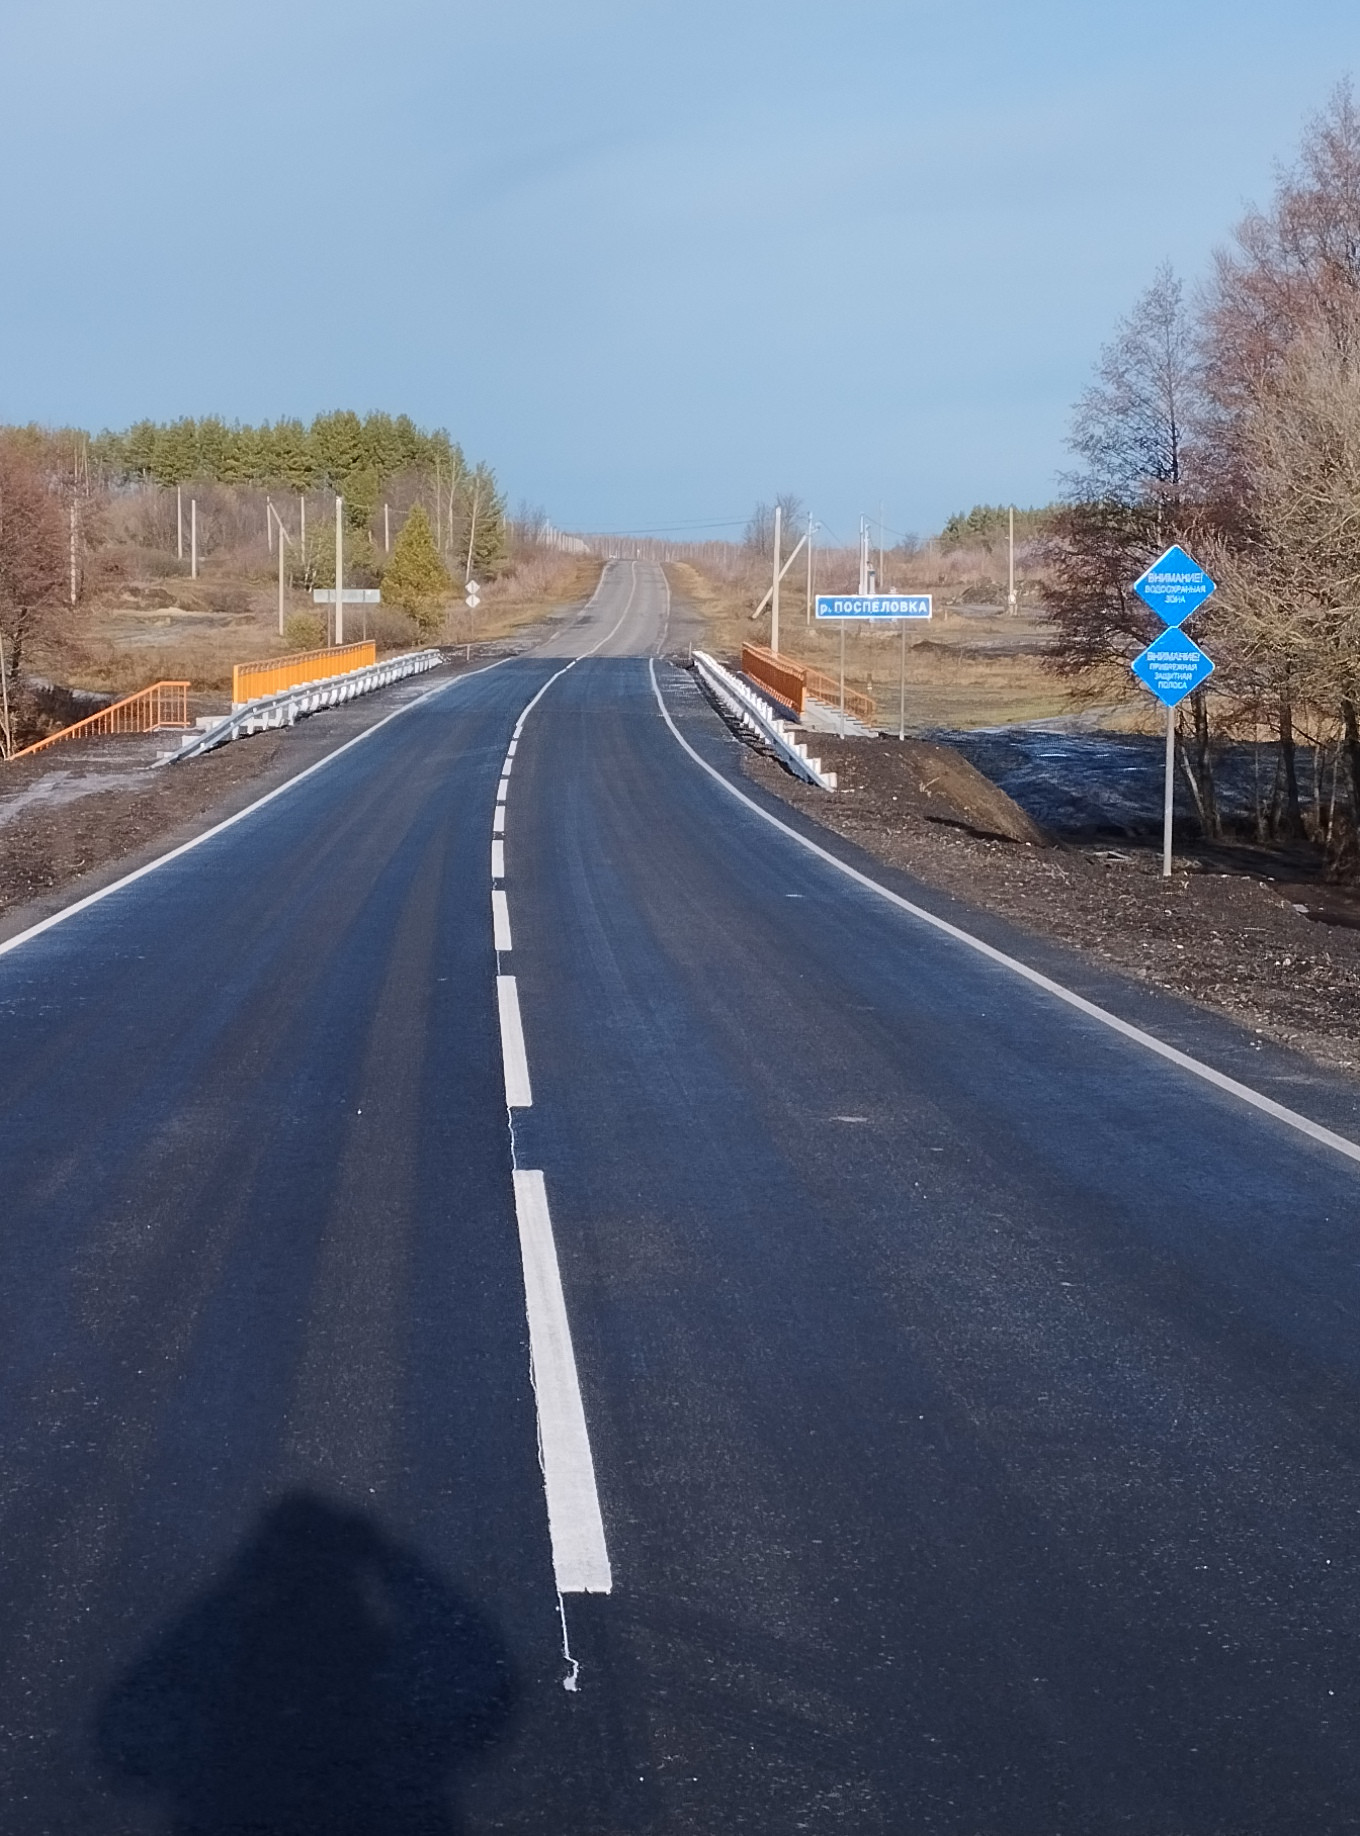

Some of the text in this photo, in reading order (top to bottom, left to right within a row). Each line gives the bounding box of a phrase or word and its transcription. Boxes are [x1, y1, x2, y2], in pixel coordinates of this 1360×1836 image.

[1147, 573, 1203, 583] ВНИМАНИЕ!
[1164, 595, 1186, 603] ЗОНА
[834, 601, 927, 613] ПОСПЕЛОВКА
[1158, 681, 1187, 689] ПОЛОСА
